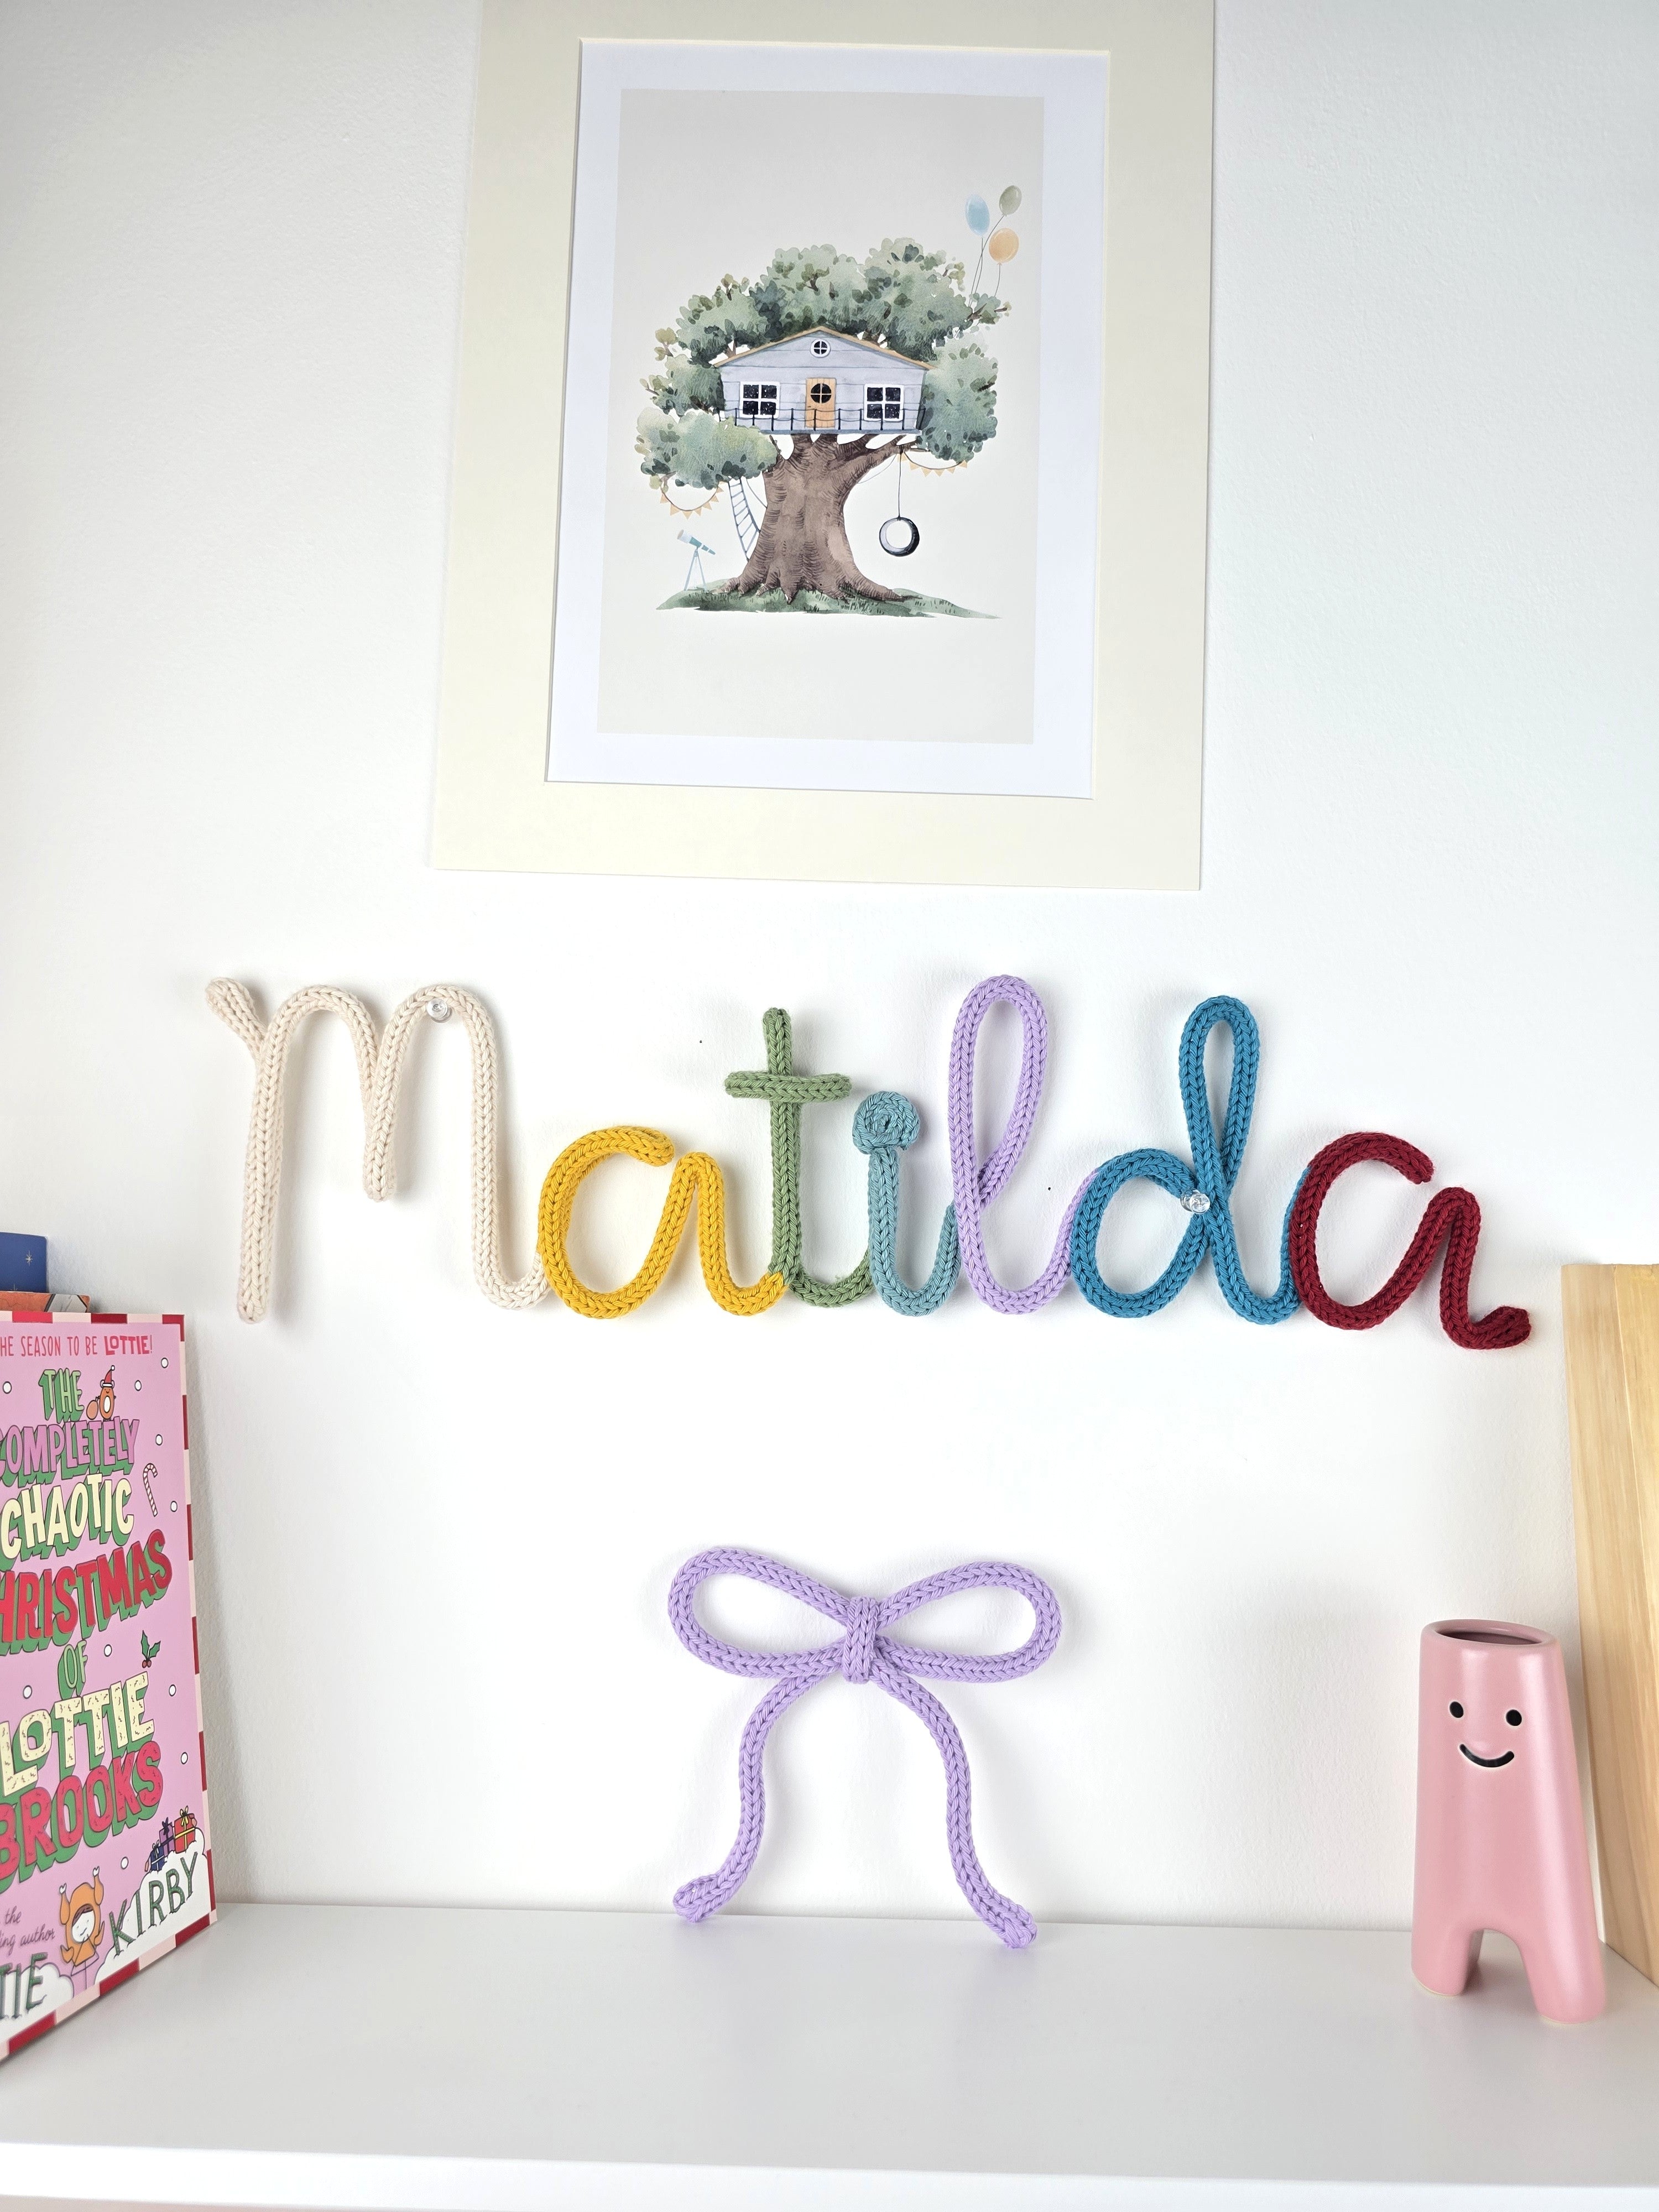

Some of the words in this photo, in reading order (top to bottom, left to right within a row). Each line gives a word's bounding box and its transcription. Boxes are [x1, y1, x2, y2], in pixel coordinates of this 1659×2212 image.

[0, 1336, 14, 1356] HE
[21, 1335, 60, 1357] SEASON
[67, 1336, 79, 1356] TO
[86, 1336, 97, 1355] BE
[104, 1334, 153, 1355] LOTTIE!
[39, 1368, 85, 1423] THE
[0, 1473, 134, 1569] CHAOTIC
[0, 1529, 172, 1653] HRISTMAS
[58, 1640, 88, 1699] OF
[0, 1671, 155, 1797] LOTTIE
[5, 1905, 22, 1924] the
[108, 1851, 197, 1955] KIRBY
[20, 1923, 55, 1947] author
